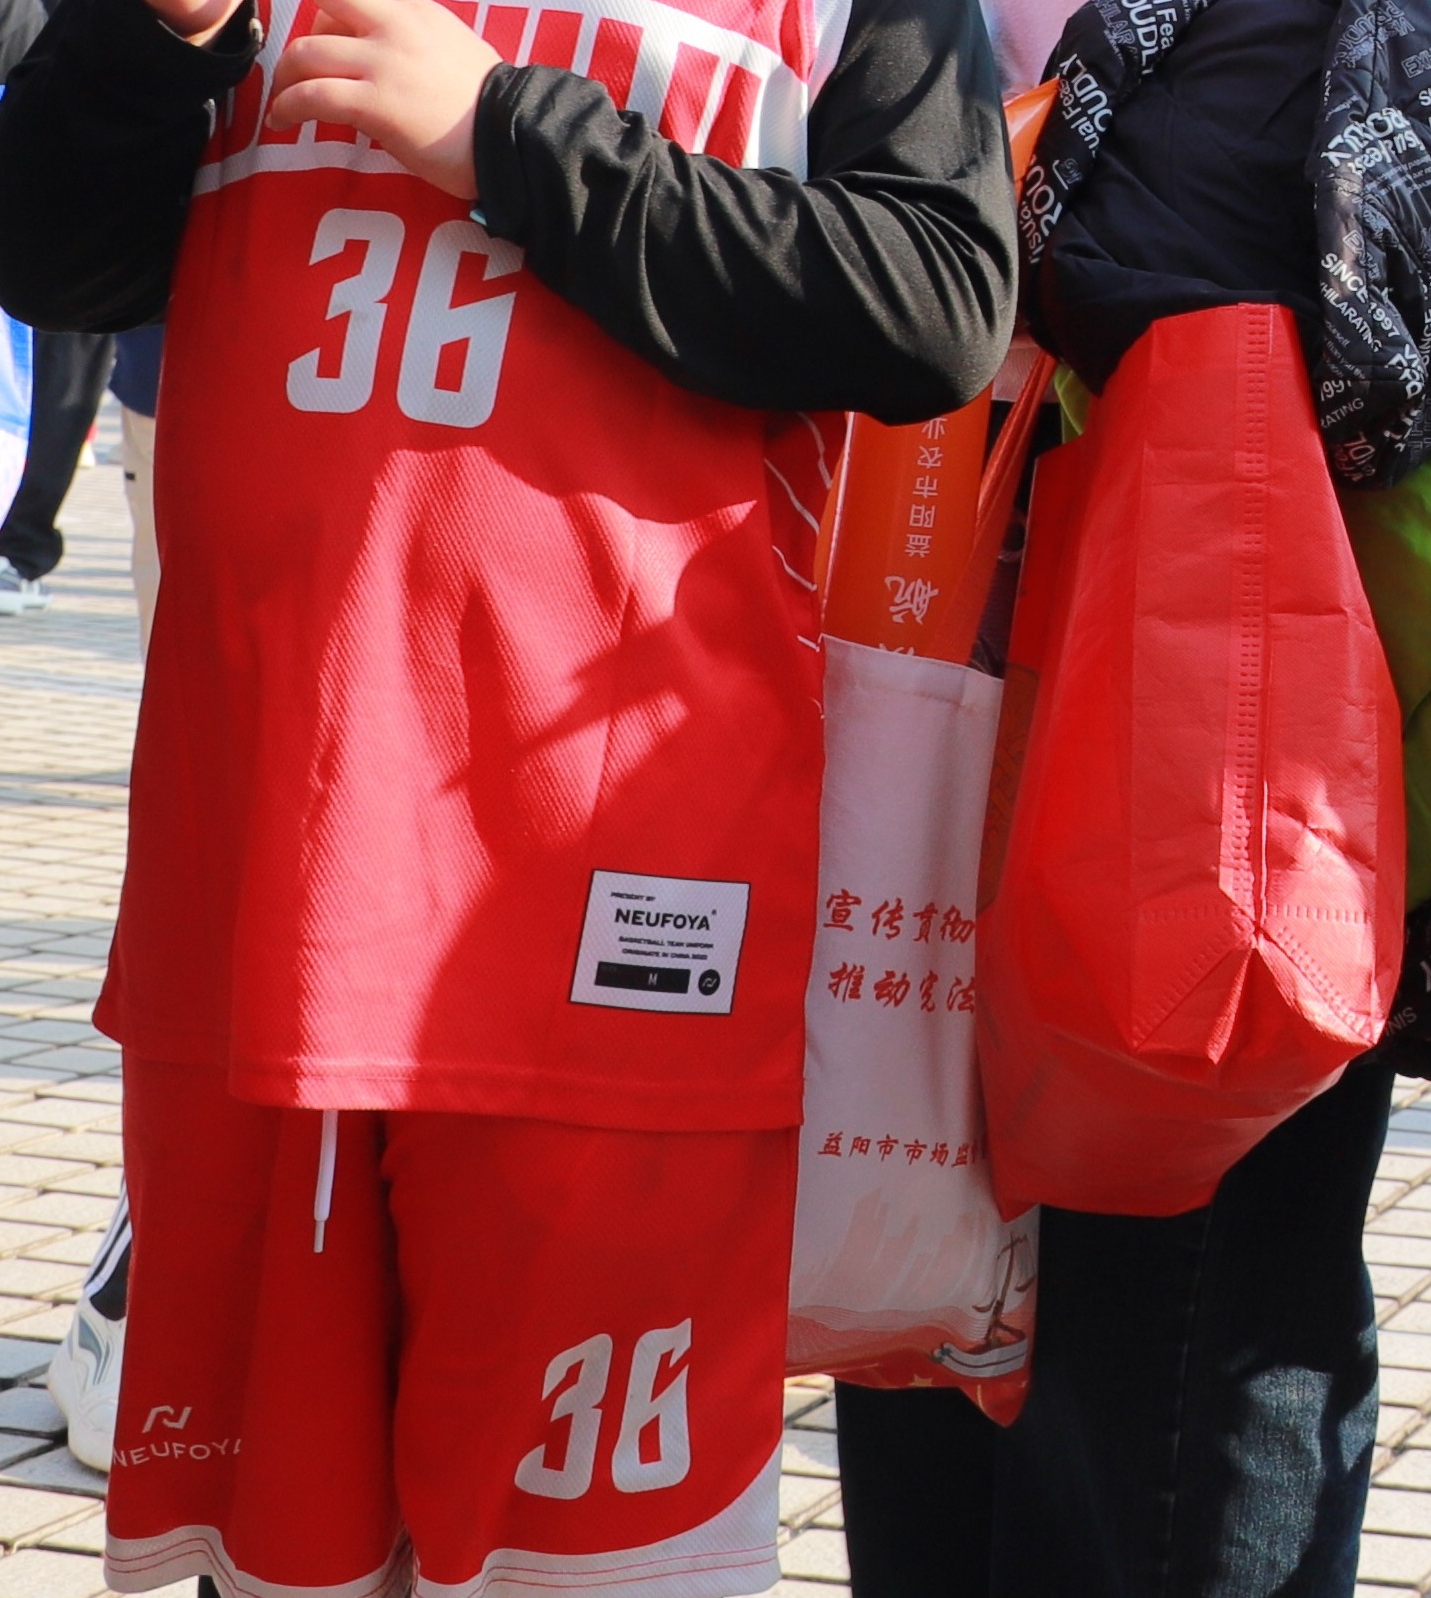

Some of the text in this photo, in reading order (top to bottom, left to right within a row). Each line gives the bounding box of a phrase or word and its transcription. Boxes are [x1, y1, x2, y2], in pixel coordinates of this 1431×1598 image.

[286, 208, 526, 429] 36
[615, 908, 710, 931] NEUFOYA
[648, 973, 658, 986] M
[514, 1317, 692, 1500] 36
